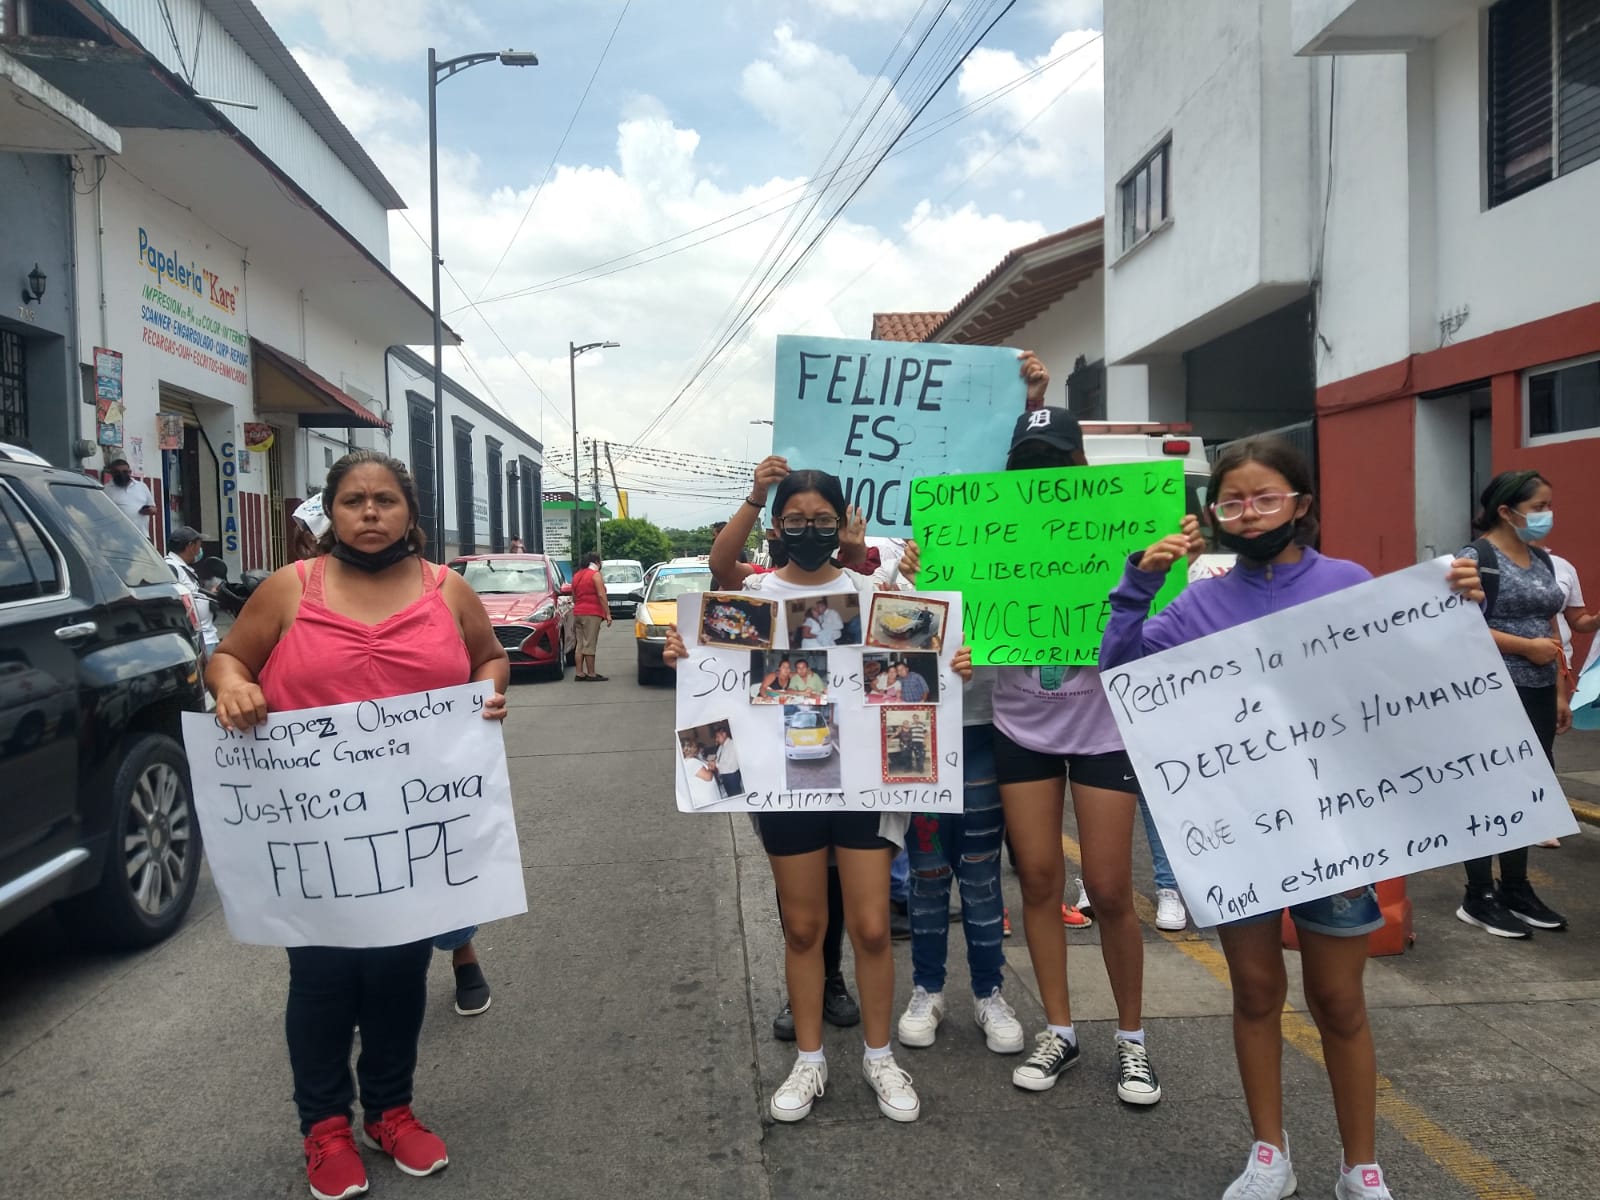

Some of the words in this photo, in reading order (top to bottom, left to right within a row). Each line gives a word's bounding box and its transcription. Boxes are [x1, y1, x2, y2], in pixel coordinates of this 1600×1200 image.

[138, 227, 203, 297] Papeleria
[798, 351, 952, 411] FELIPE
[844, 414, 900, 462] ES
[221, 442, 238, 552] COPIAS
[914, 479, 1000, 512] SOMOS
[1143, 471, 1179, 496] DE
[923, 523, 1018, 548] FELIPE
[1042, 519, 1157, 542] PEDIMOS
[925, 563, 954, 583] SU
[1108, 658, 1242, 725] Pedimos
[1255, 647, 1284, 674] la
[1234, 697, 1263, 723] de
[253, 716, 338, 747] Lopez
[357, 692, 455, 733] Obrador
[472, 692, 484, 714] y
[1154, 713, 1347, 795] DERECHOS
[1361, 670, 1504, 733] HUMANOS
[333, 737, 410, 763] Garcia
[220, 783, 367, 825] Justicia
[859, 788, 953, 810] JUSTICIA
[1184, 818, 1236, 857] QUE
[1254, 809, 1294, 835] SA
[1317, 778, 1398, 821] HAGA
[1399, 739, 1534, 796] JUSTICIA
[268, 814, 479, 899] FELIPE
[1207, 883, 1260, 920] Papá
[1281, 848, 1389, 893] estamos
[1407, 833, 1448, 857] con
